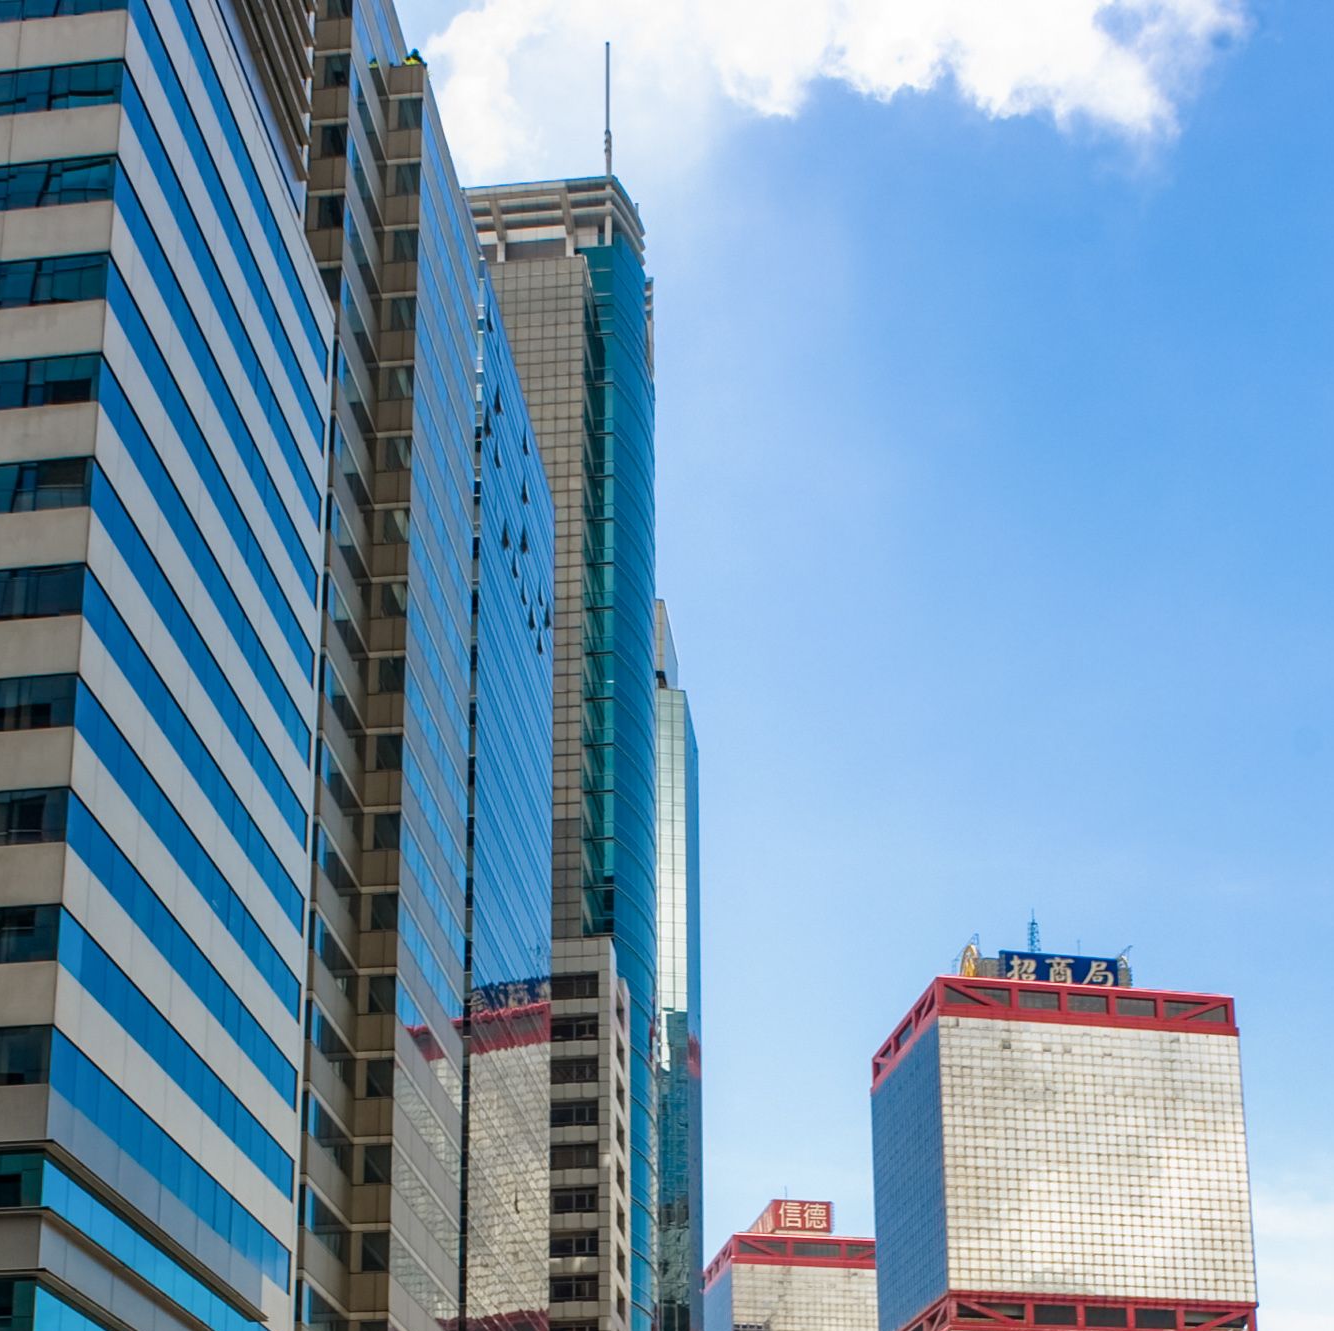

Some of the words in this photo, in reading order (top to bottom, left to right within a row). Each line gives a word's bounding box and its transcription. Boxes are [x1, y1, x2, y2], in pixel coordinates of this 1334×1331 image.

[1005, 955, 1115, 986] 招商局
[778, 1202, 827, 1230] 信德
